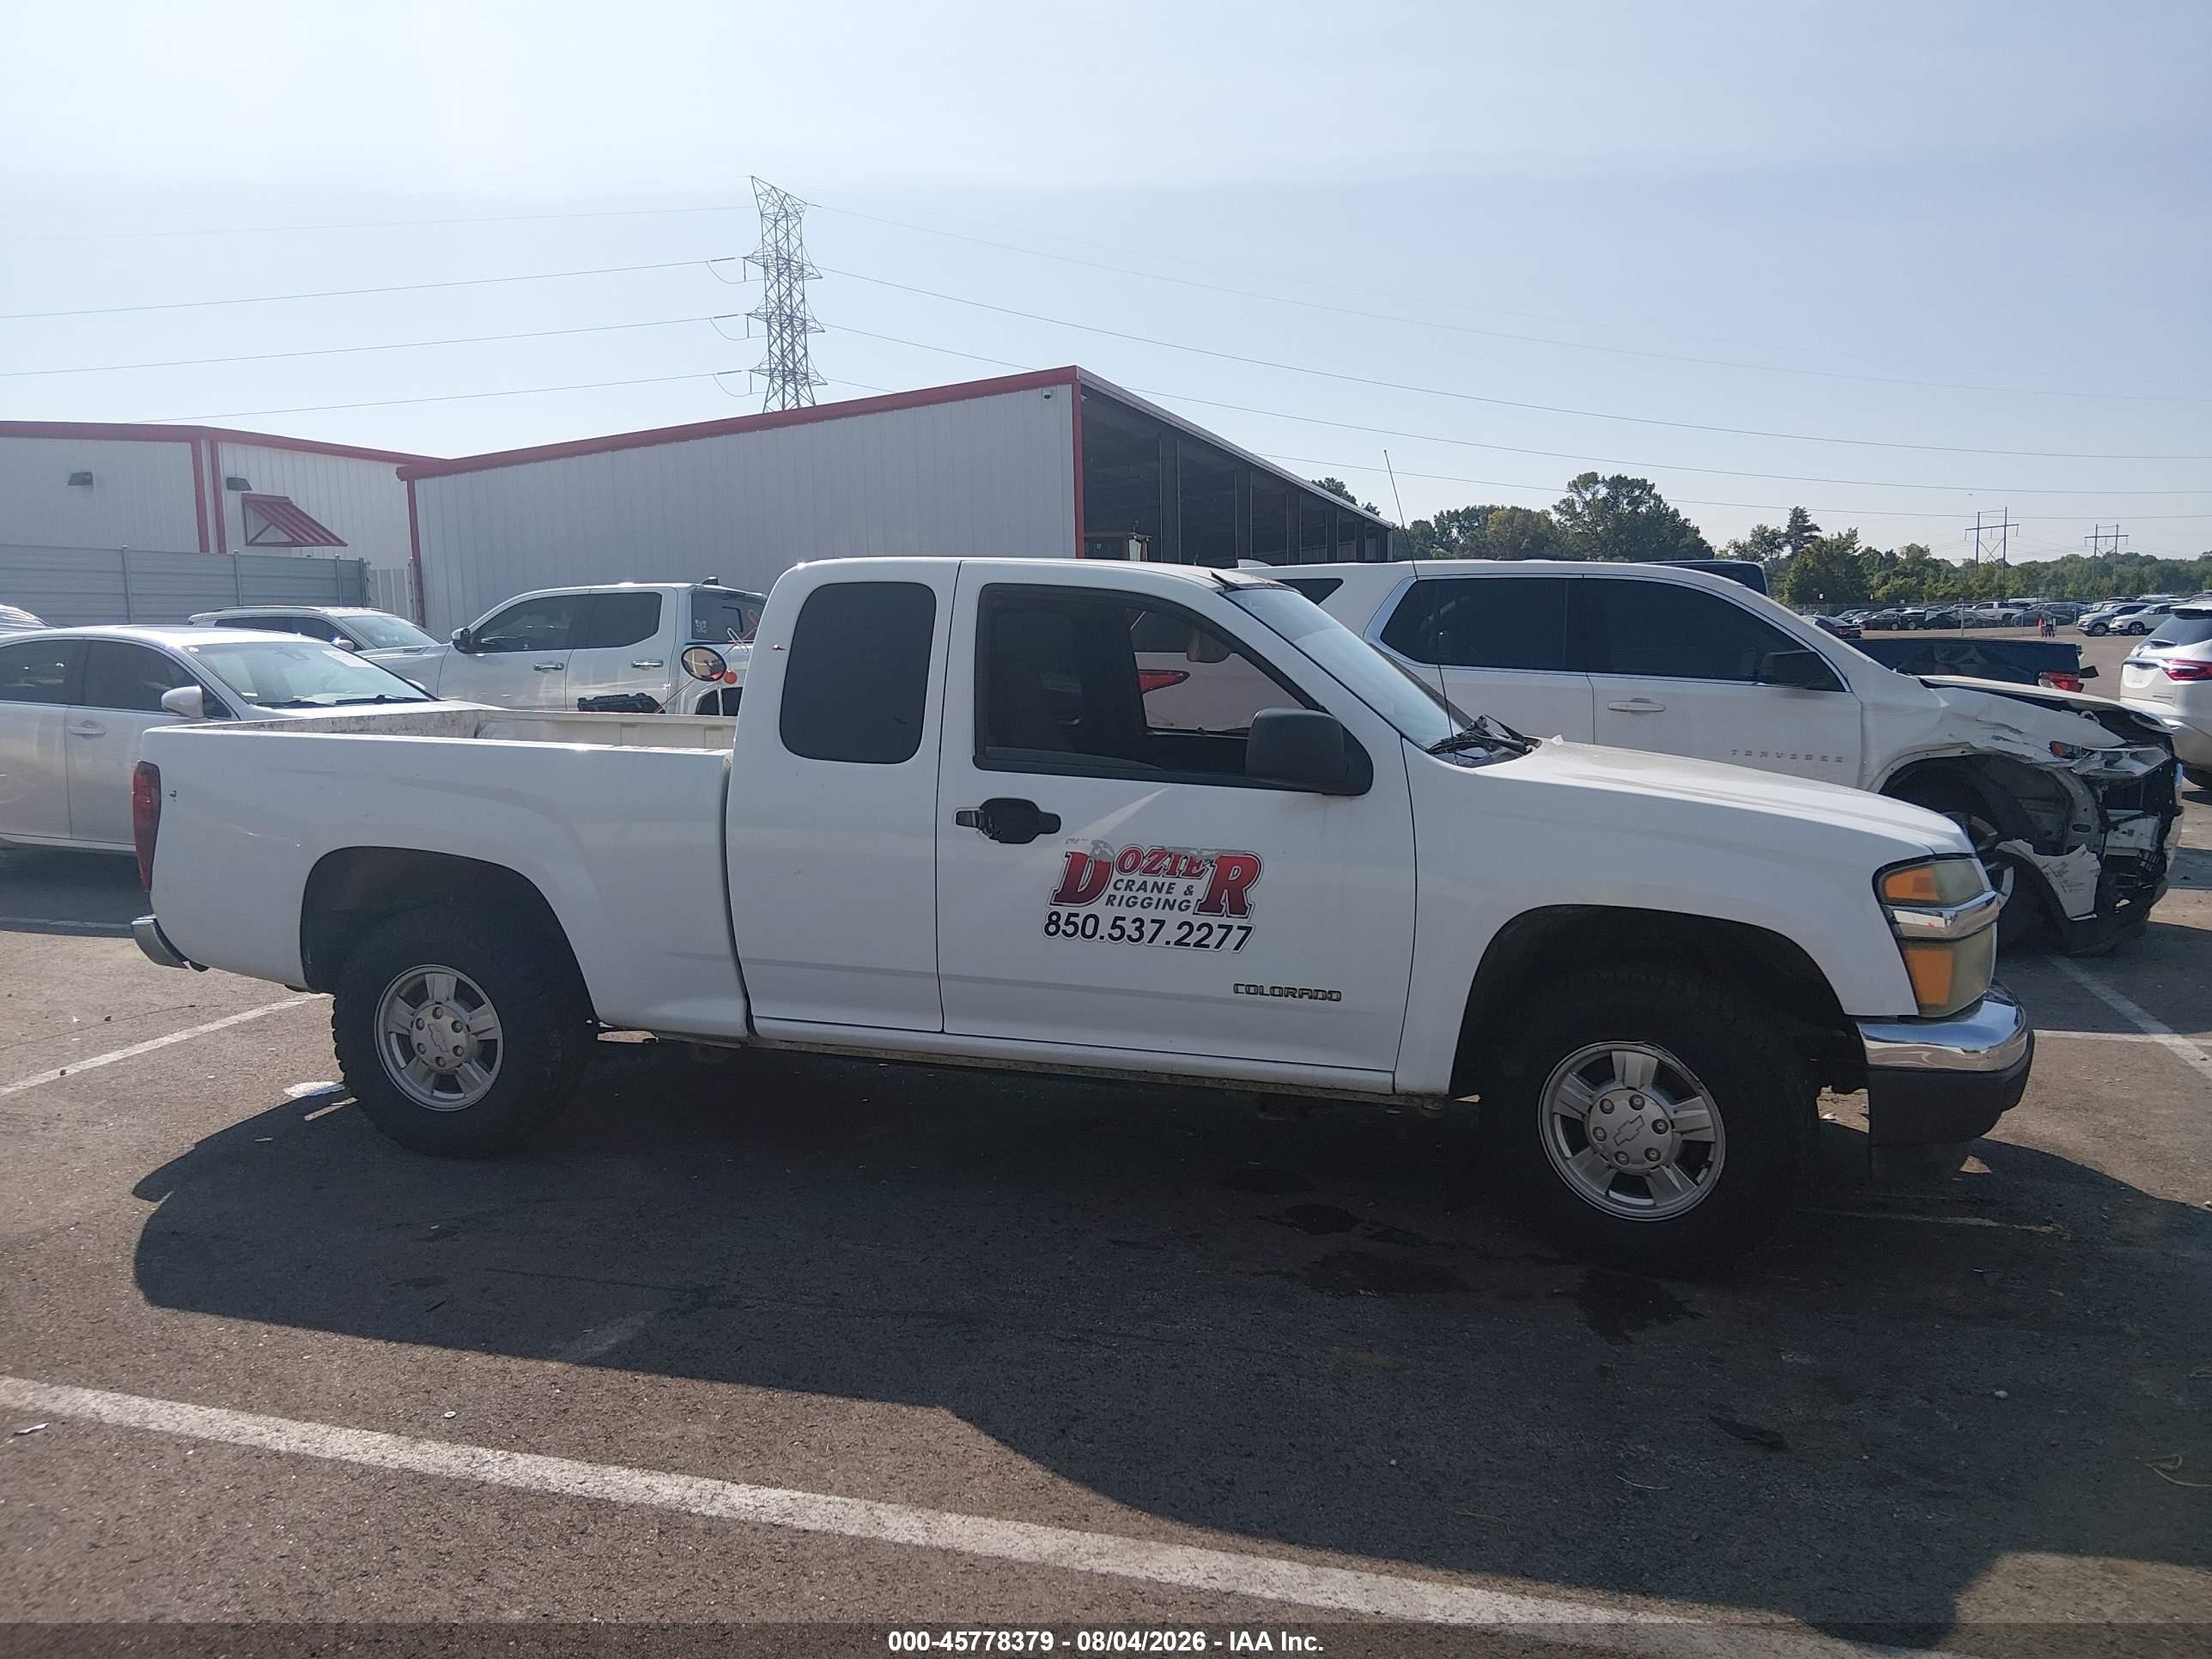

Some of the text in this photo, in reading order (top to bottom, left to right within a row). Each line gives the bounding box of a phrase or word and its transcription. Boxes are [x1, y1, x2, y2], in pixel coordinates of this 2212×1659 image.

[1050, 846, 1263, 918] DOZIER
[1113, 878, 1194, 896] CRANE &
[1104, 894, 1191, 913] RIGGING
[1043, 910, 1254, 951] 850.537.2277
[1233, 982, 1342, 1002] COLORADO
